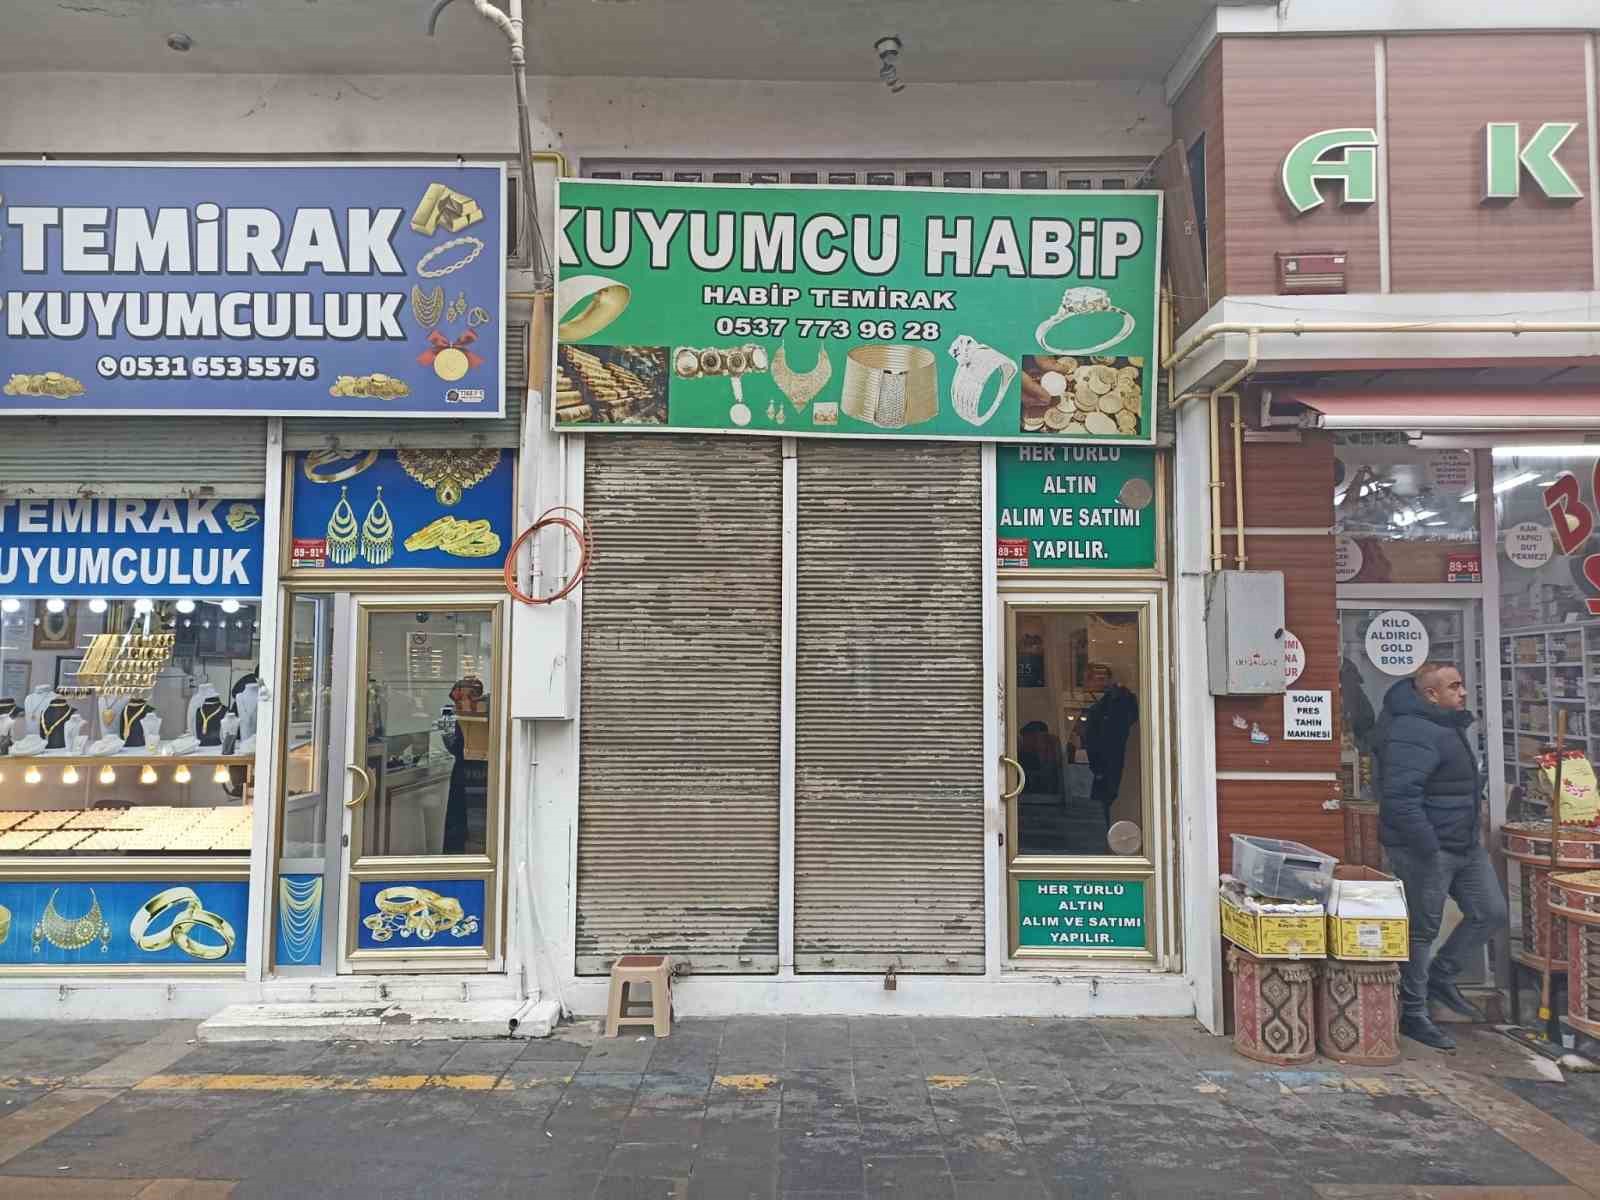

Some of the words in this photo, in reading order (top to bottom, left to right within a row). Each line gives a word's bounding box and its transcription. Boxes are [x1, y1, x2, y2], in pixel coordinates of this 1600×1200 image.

[7, 291, 404, 338] KUYUMCULUK
[716, 317, 788, 337] 0537
[797, 319, 851, 338] 773
[858, 321, 896, 339] 96
[903, 321, 941, 341] 28
[121, 357, 187, 378] 0531
[192, 357, 243, 378] 653
[248, 357, 316, 379] 5576
[1019, 446, 1056, 462] HER
[1043, 476, 1096, 494] ALTIN
[1000, 508, 1044, 526] ALIM
[1050, 508, 1073, 526] VE
[1079, 508, 1141, 526] SATIMI
[1032, 540, 1109, 559] YAPILIR.
[1371, 631, 1422, 641] ALDIRICI
[1380, 643, 1413, 653] GOLD
[1381, 655, 1414, 665] BOKS
[1296, 707, 1321, 715] PRES
[1038, 885, 1068, 895] HER
[1058, 901, 1104, 911] ALTIN
[1022, 917, 1059, 927] ALIM
[1064, 917, 1084, 927] VE
[1088, 917, 1141, 927] SATIMI
[1050, 933, 1115, 943] YAPILIR.
